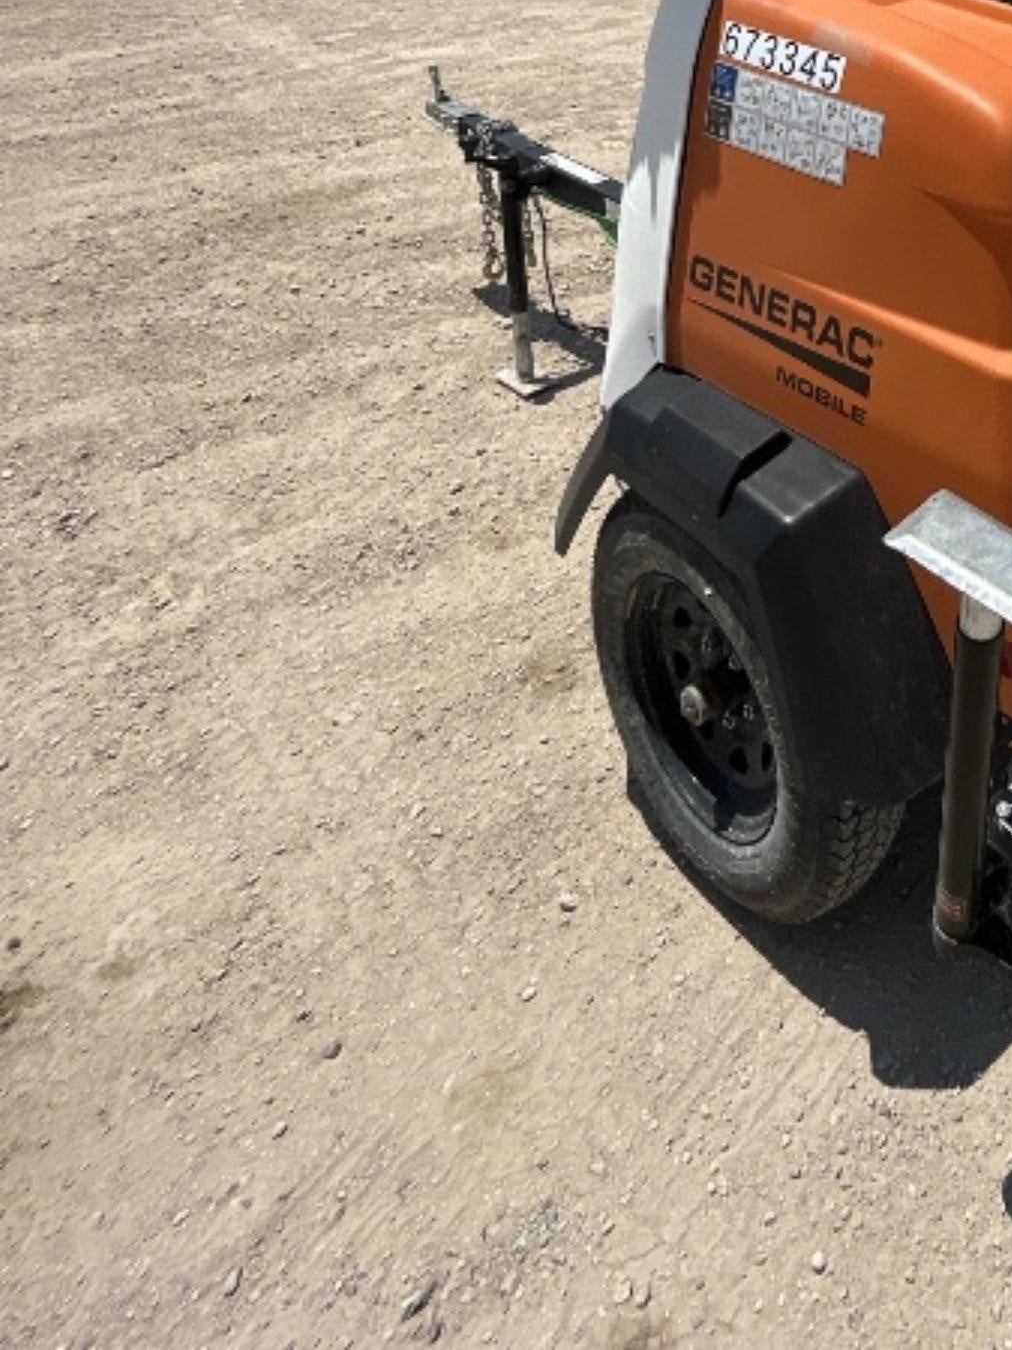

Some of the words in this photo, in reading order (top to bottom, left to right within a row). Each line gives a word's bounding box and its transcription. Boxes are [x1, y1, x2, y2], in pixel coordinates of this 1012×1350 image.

[724, 22, 841, 90] 673345
[688, 254, 874, 369] GENERAC
[775, 365, 868, 427] MOBILE
